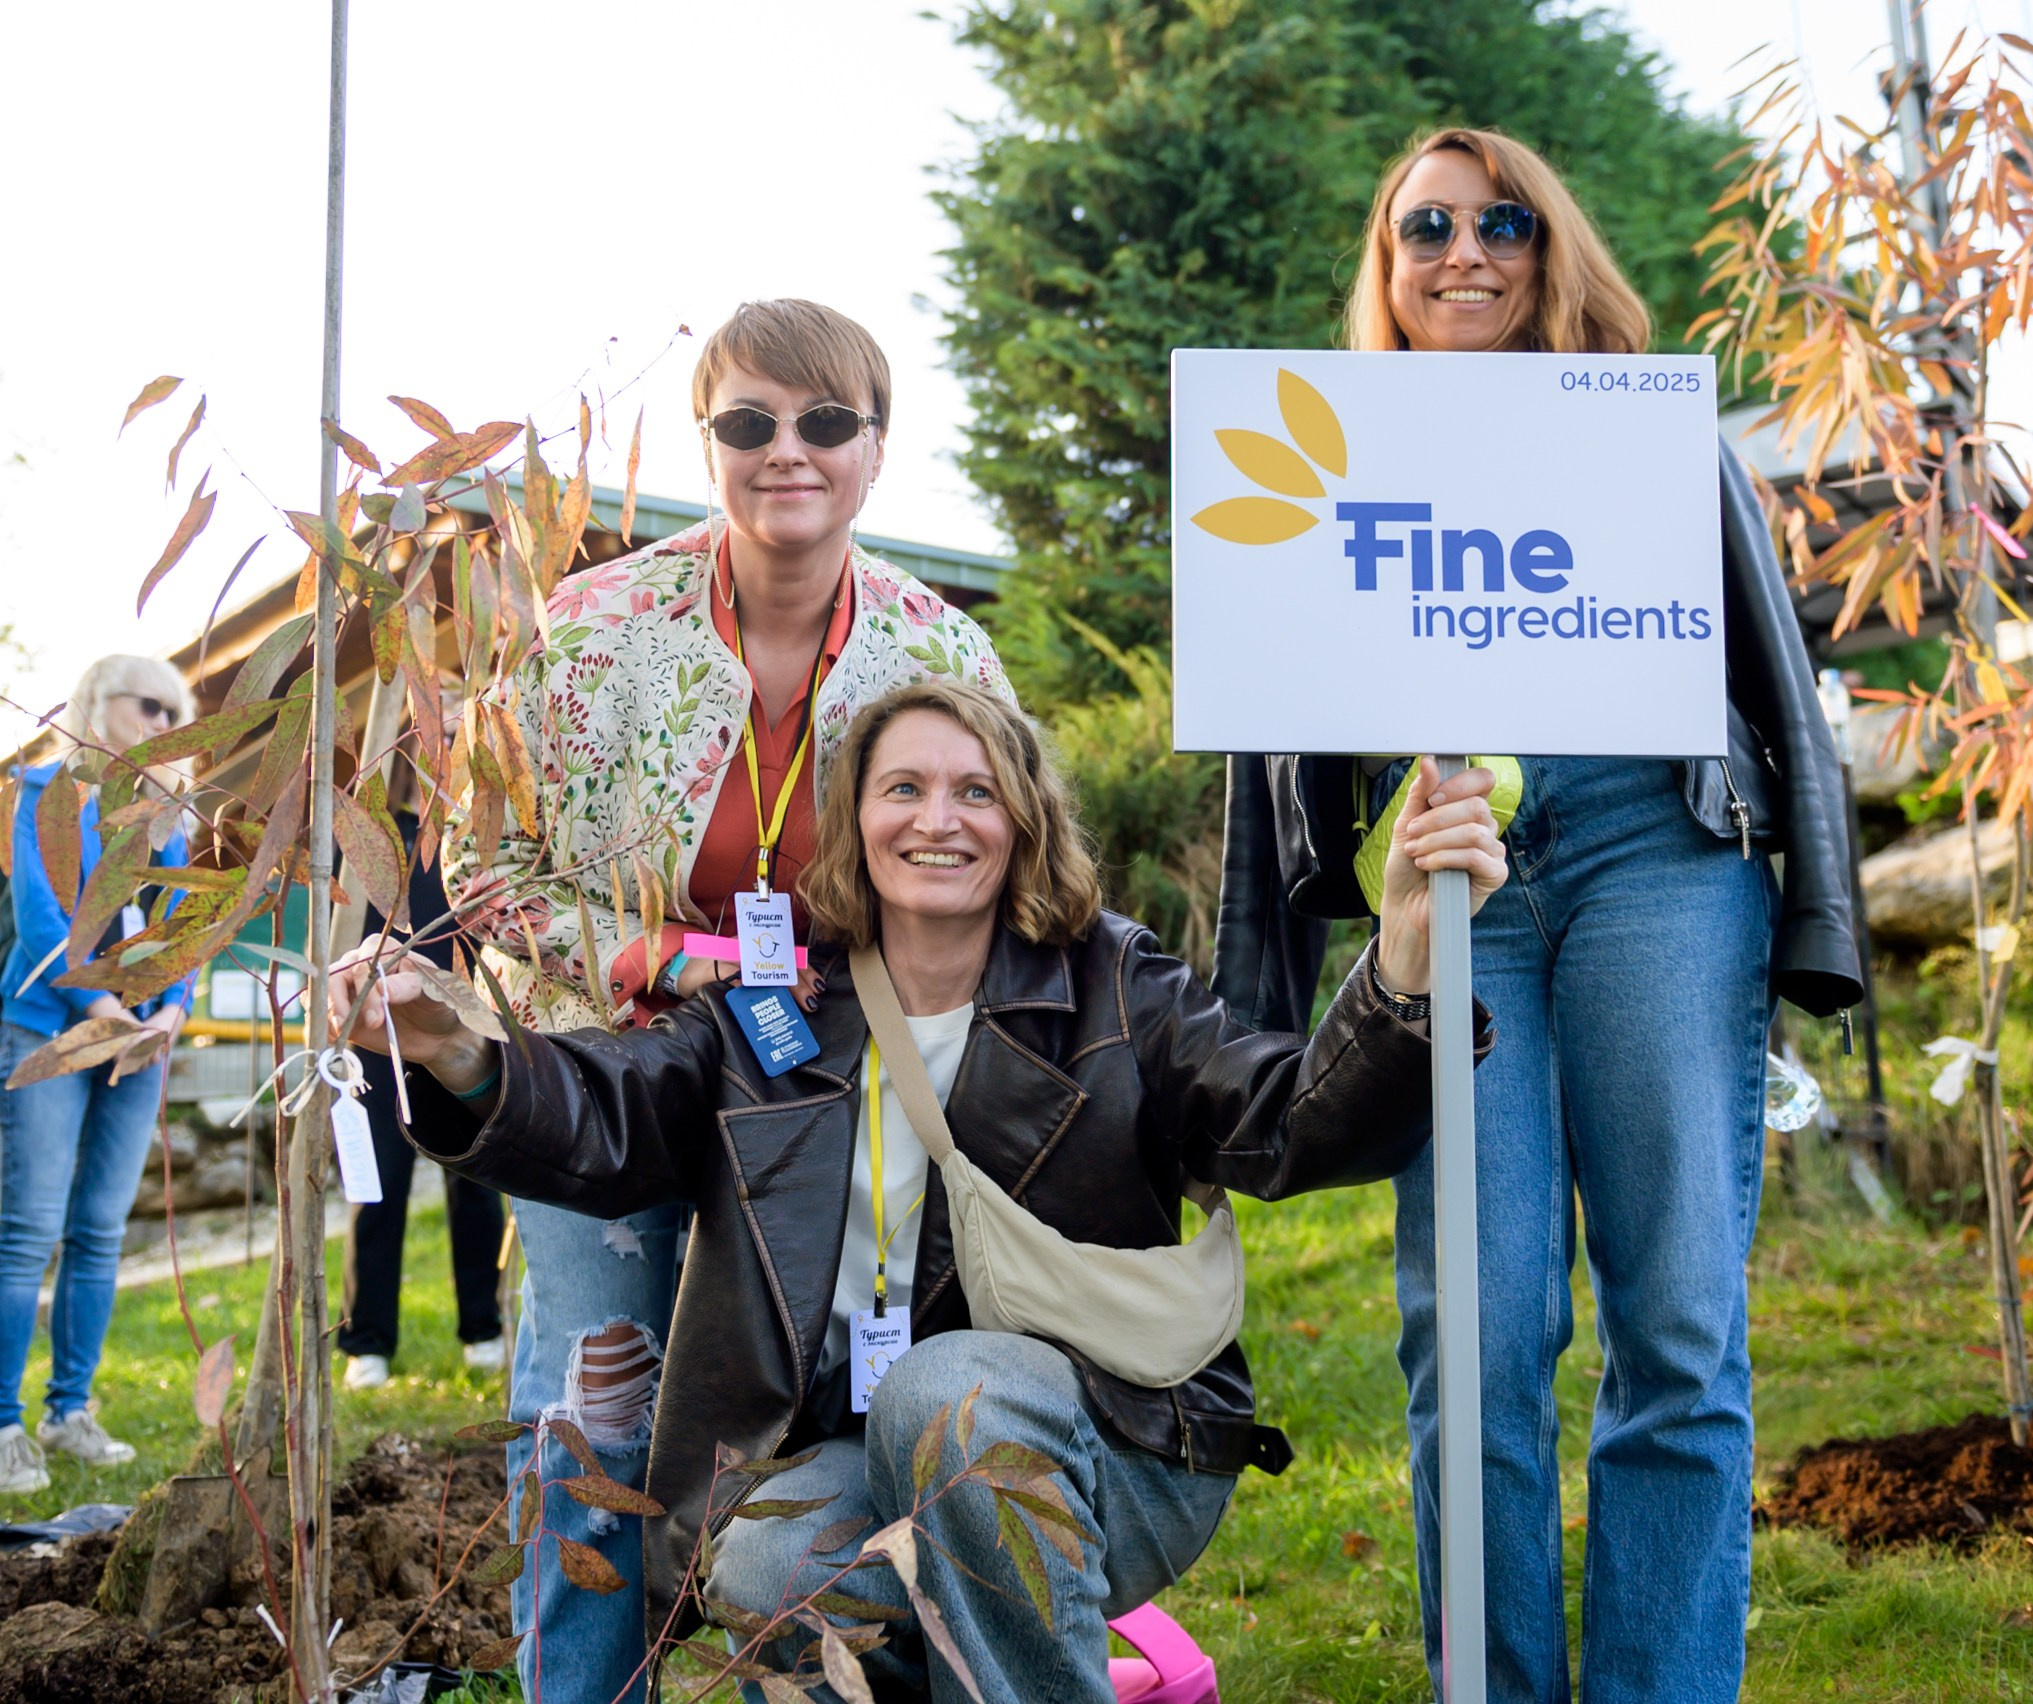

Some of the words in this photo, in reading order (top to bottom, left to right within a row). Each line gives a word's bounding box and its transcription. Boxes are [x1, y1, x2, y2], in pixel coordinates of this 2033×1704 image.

[1561, 371, 1701, 393] 04.04.2025
[1336, 502, 1573, 593] Fine
[1412, 594, 1712, 650] ingredients
[745, 911, 783, 923] Турист
[754, 961, 785, 970] Yellow
[751, 971, 789, 980] Tourism
[754, 1002, 782, 1020] PEOPLE
[757, 1008, 786, 1026] CLOSER
[860, 1328, 901, 1342] Турист
